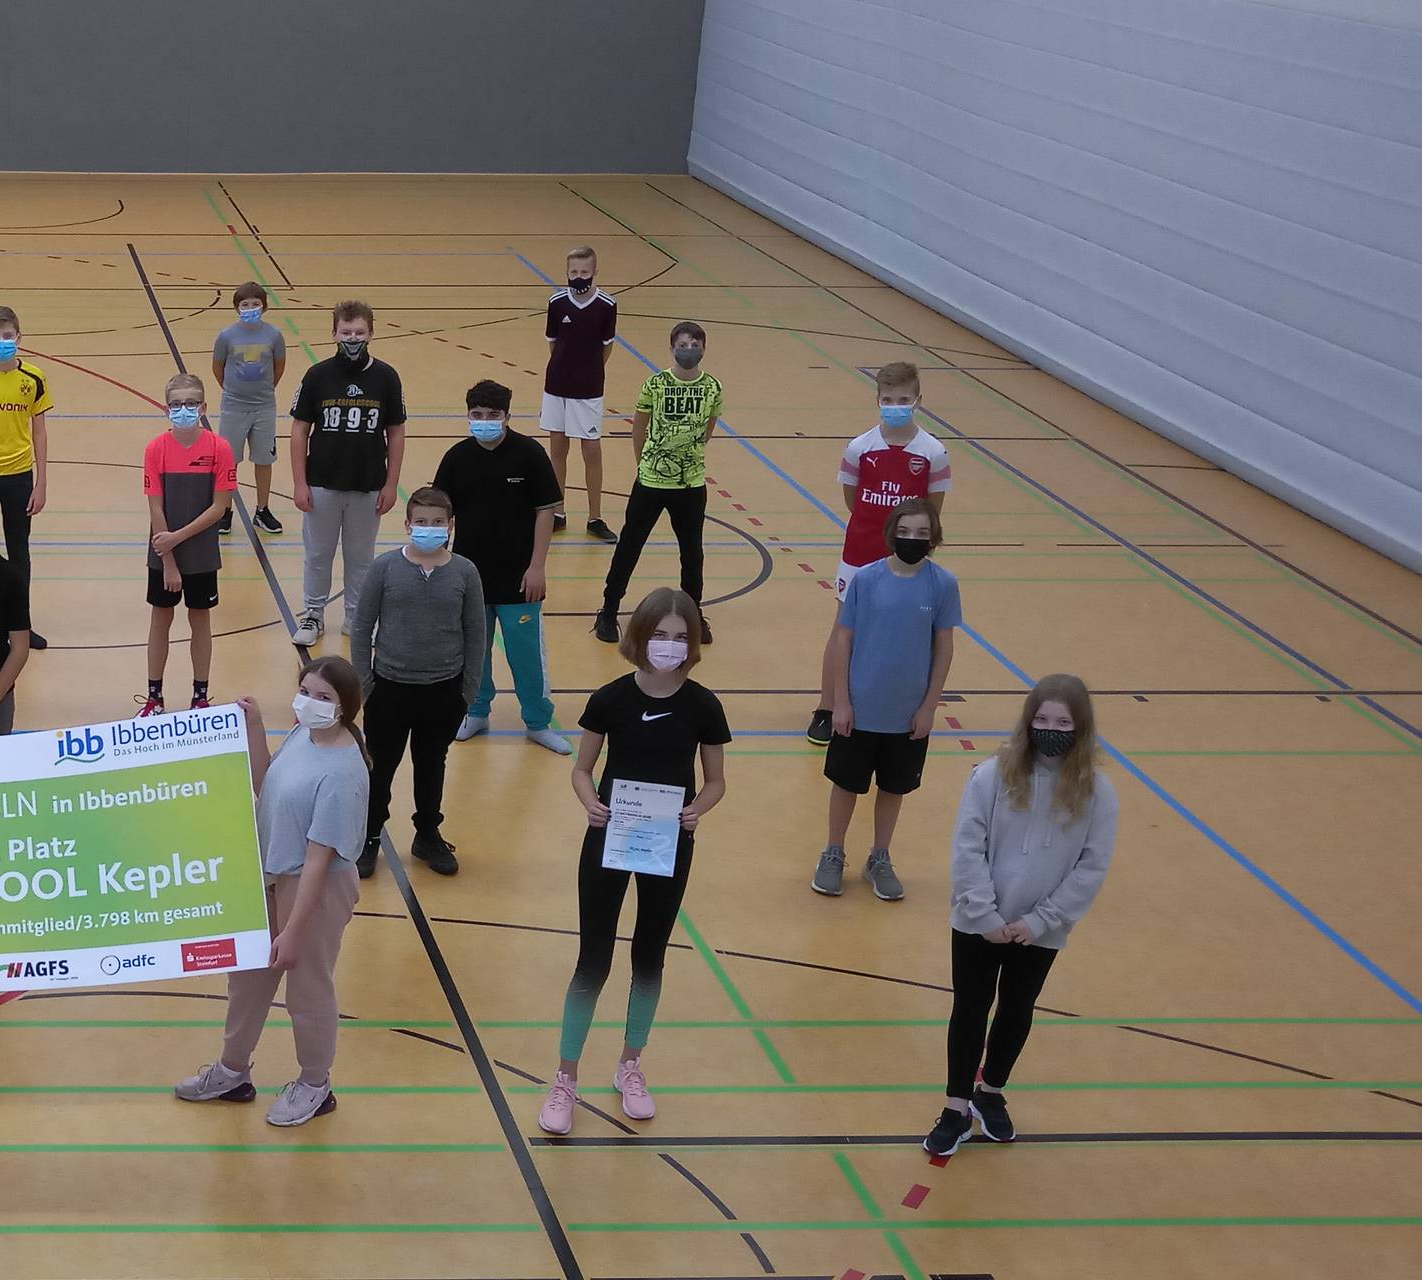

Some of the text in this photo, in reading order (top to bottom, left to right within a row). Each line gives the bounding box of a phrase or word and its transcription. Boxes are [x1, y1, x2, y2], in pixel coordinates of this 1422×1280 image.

[665, 387, 704, 397] DROP THE
[665, 397, 704, 414] BEAT
[881, 480, 901, 494] Fly
[111, 711, 239, 746] Ibbenbüren
[58, 726, 104, 758] ibb
[114, 730, 240, 757] Das Hoch im Münsterland
[52, 795, 73, 814] in
[79, 779, 208, 811] Ibbenbüren
[8, 836, 77, 861] Platz
[98, 852, 224, 899] Kepler
[134, 910, 159, 925] km
[163, 901, 224, 925] gesamt
[24, 959, 70, 978] AGFS
[122, 954, 156, 969] adfc
